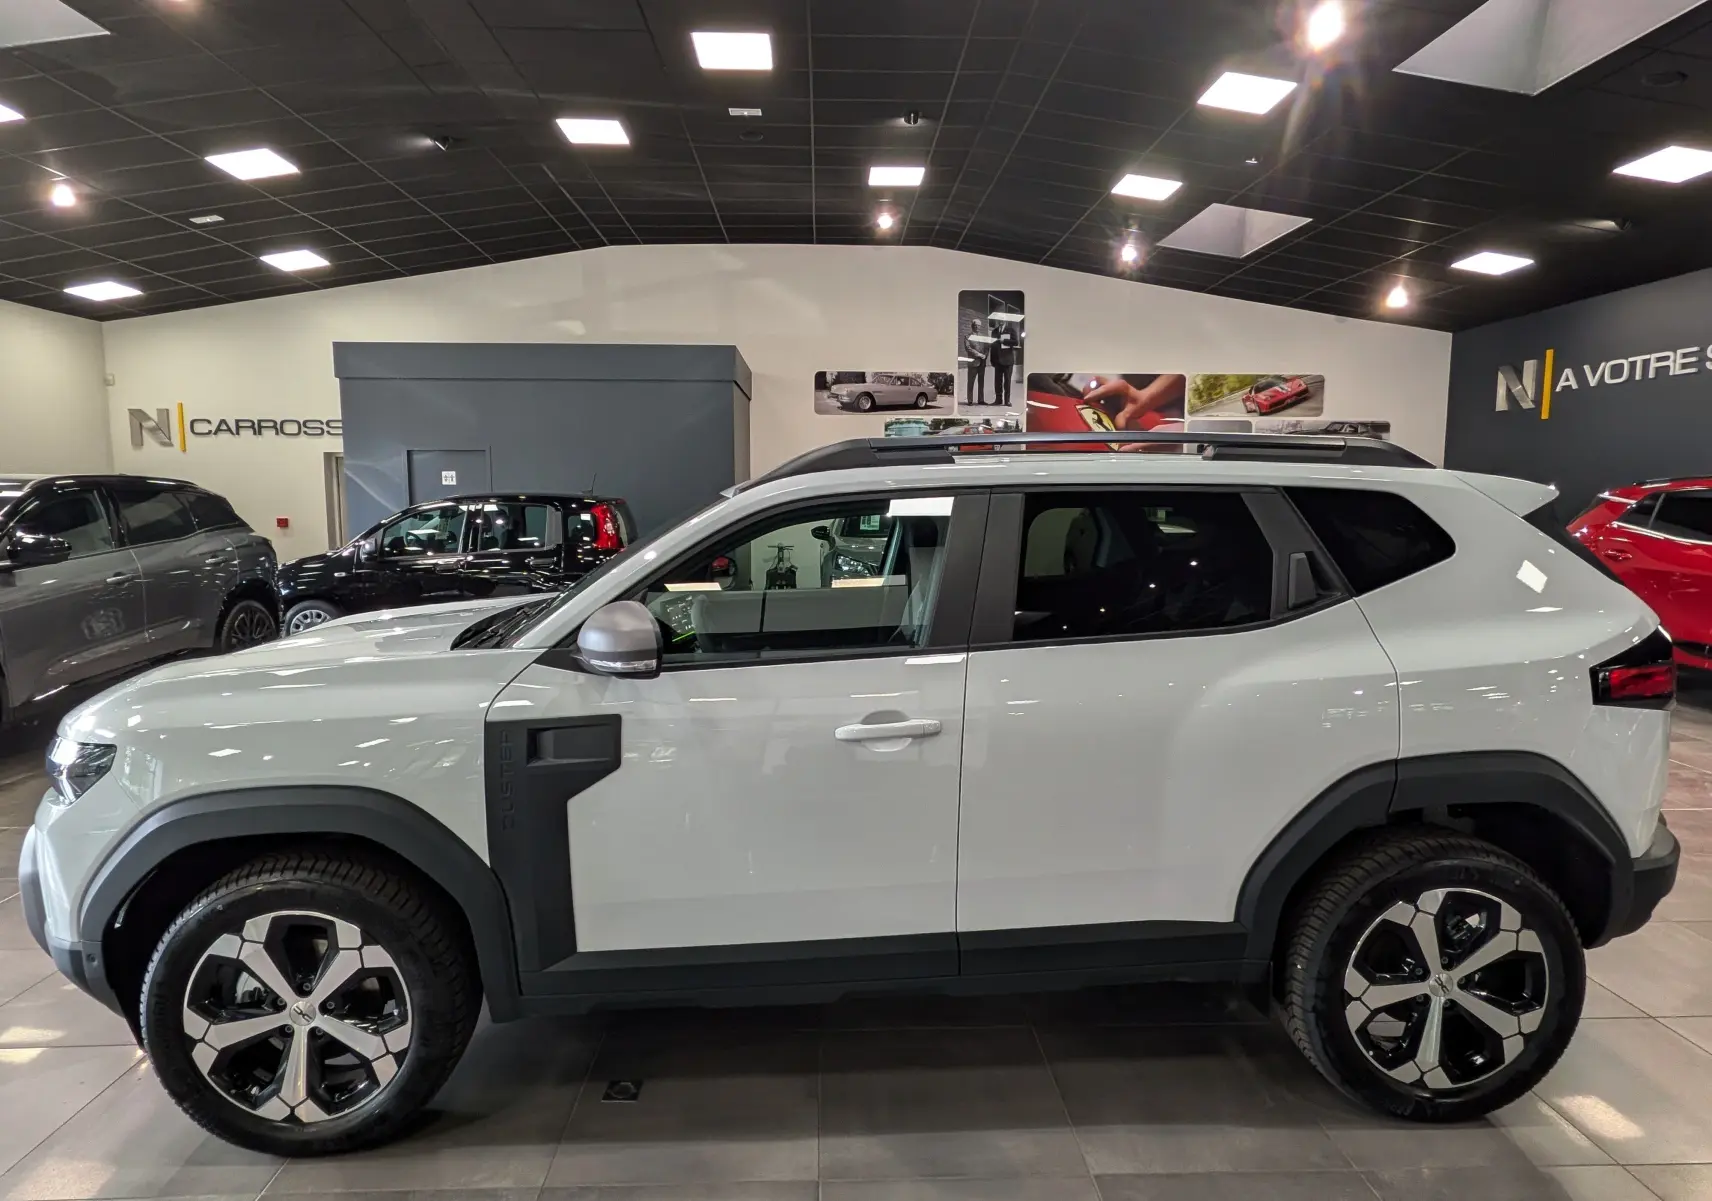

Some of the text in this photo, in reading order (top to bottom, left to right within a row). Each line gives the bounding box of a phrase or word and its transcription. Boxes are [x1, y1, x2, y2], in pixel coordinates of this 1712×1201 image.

[1555, 368, 1578, 392] A
[1583, 347, 1700, 387] VOTRE
[190, 418, 343, 436] CARROSS
